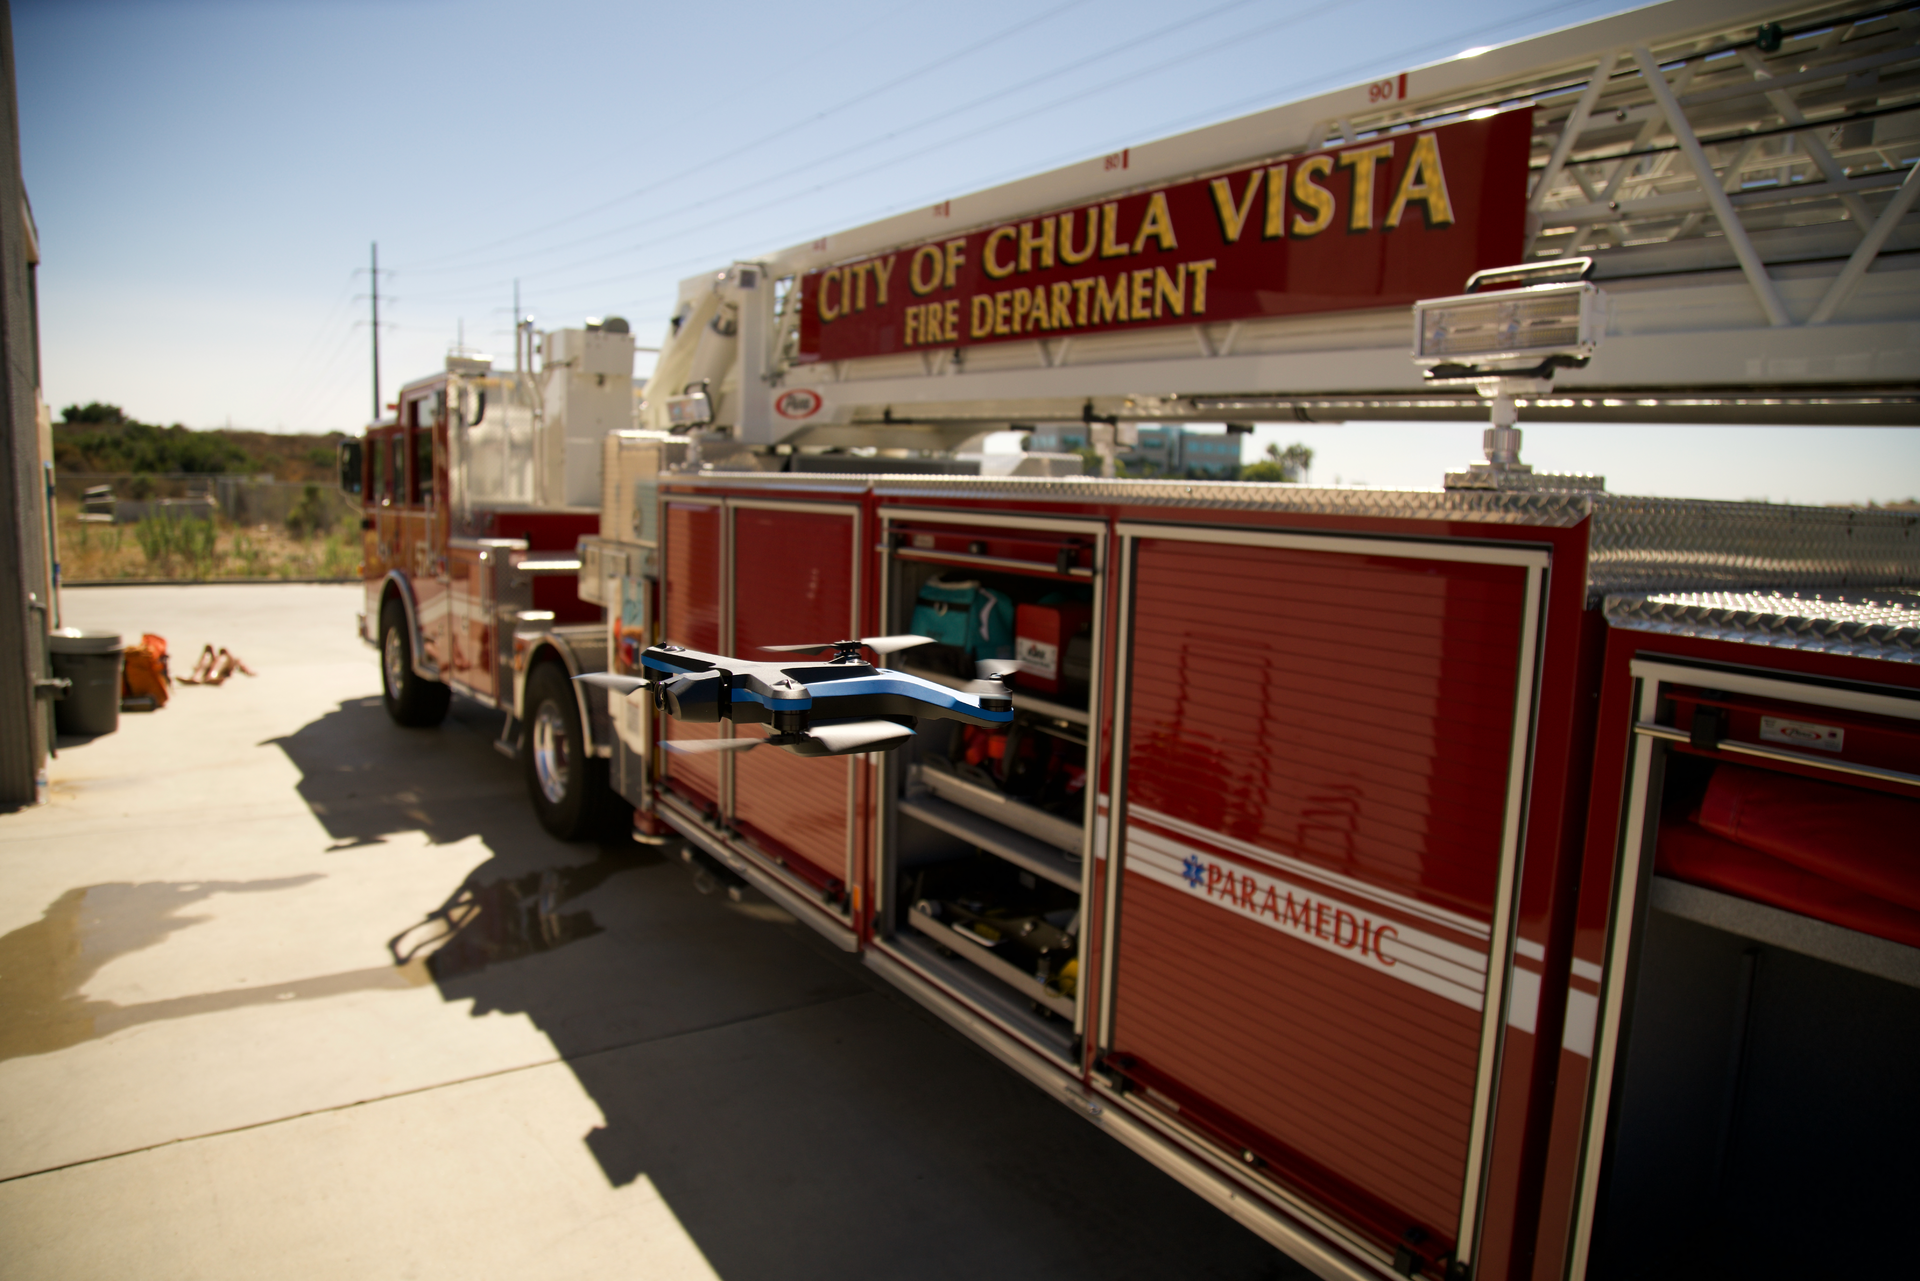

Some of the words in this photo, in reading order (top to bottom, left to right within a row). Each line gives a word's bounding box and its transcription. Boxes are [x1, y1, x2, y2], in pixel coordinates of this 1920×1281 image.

[1368, 81, 1393, 104] 90
[817, 254, 897, 324] CITY
[910, 236, 966, 297] OF
[982, 191, 1178, 280] CHULA
[1210, 131, 1456, 244] VISTA
[904, 299, 960, 347] FIRE
[969, 258, 1217, 341] DEPARTMENT
[1206, 862, 1399, 968] PARAMEDIC
